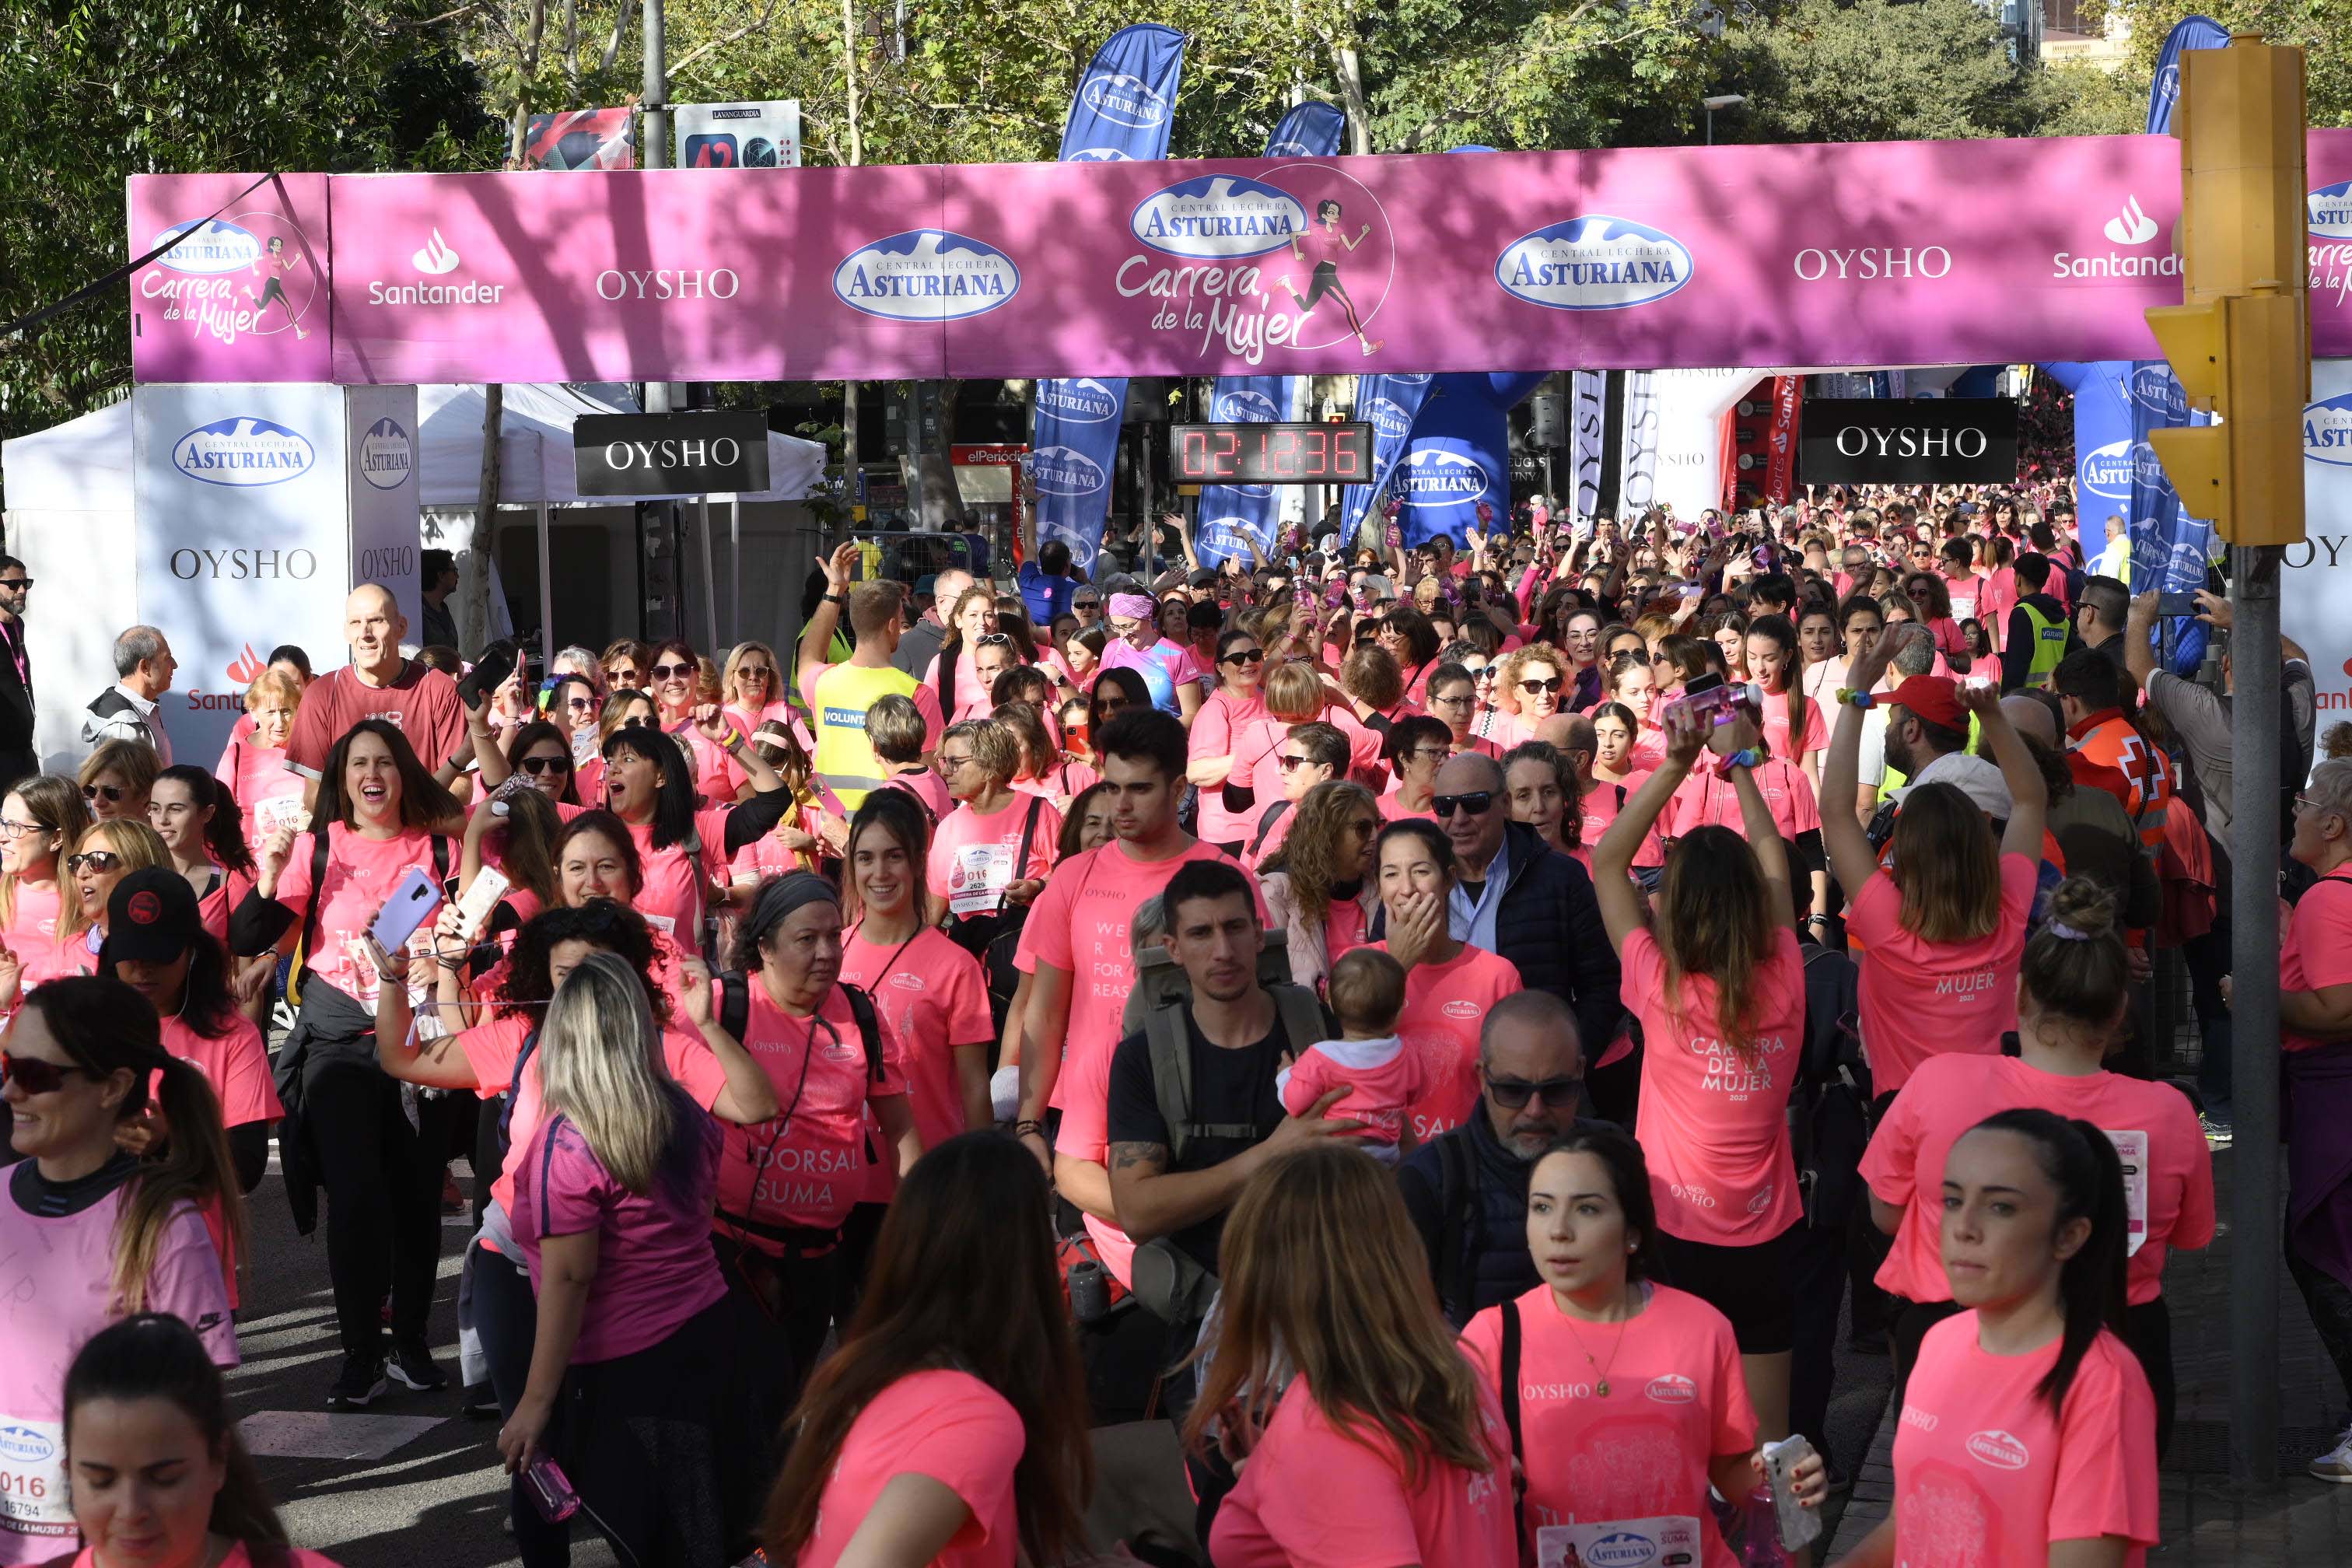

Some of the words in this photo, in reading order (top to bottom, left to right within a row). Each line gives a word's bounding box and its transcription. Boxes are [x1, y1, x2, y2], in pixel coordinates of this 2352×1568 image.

[1087, 85, 1160, 120] ASTURIANA
[1171, 203, 1227, 212] CENTRAL
[1233, 201, 1288, 212] LECHERA
[1143, 205, 1293, 238] ASTURIANA
[1541, 248, 1602, 258] CENTRAL
[1608, 247, 1671, 257] LECHERA
[1794, 246, 1952, 281] OYSHO
[877, 261, 934, 271] CENTRAL
[940, 261, 999, 269] LECHERA
[1115, 254, 1262, 298] Carrera
[1510, 252, 1678, 285] ASTURIANA
[141, 270, 233, 299] Carrera
[596, 268, 740, 300] OYSHO
[848, 264, 1006, 297] ASTURIANA
[2326, 267, 2340, 289] la
[369, 281, 504, 305] Santander
[163, 300, 180, 320] de
[184, 300, 197, 320] la
[194, 297, 268, 345] Mujer
[1151, 299, 1181, 331] de
[1184, 299, 1204, 331] la
[1199, 294, 1316, 366] Mujer
[1035, 384, 1109, 415] ASTURIANA
[1078, 390, 1109, 401] LECHERA
[1184, 432, 1356, 474] 02:12:36
[1836, 426, 1987, 458] OYSHO
[184, 443, 304, 469] ASTURIANA
[364, 444, 409, 472] ASTURIANA
[605, 437, 740, 471] OYSHO
[968, 450, 1020, 463] elPeriódi
[1657, 452, 1704, 467] YSHO
[1034, 467, 1097, 488] STURIANA
[1393, 473, 1482, 494] ASTURIANA
[2087, 461, 2133, 485] ASTU
[170, 548, 317, 579] OYSHO
[362, 545, 413, 579] OYSHO
[187, 688, 242, 710] Sant
[967, 869, 987, 881] 016
[1085, 887, 1126, 901] OYSHO
[838, 971, 861, 981] SHO
[1094, 962, 1123, 978] FOR
[1093, 982, 1129, 999] REAS
[1935, 972, 1994, 995] MUJER
[1446, 1006, 1478, 1015] ASTURIANA
[753, 1040, 791, 1054] OYSHO
[1707, 1057, 1737, 1076] DE
[1701, 1073, 1773, 1091] MUJER
[755, 1146, 858, 1173] DORSAL
[754, 1178, 834, 1203] SUMA
[198, 1312, 221, 1324] NIKE
[1524, 1382, 1590, 1400] OYSHO
[1649, 1385, 1695, 1398] ASTURIANA
[0, 1471, 46, 1498] 016
[4, 1500, 40, 1517] 16794
[6, 1521, 16, 1531] DE
[18, 1522, 30, 1532] LA
[30, 1524, 65, 1535] MUJER
[1661, 1535, 1691, 1546] SUMA
[1591, 1547, 1653, 1563] ASTURIANA
